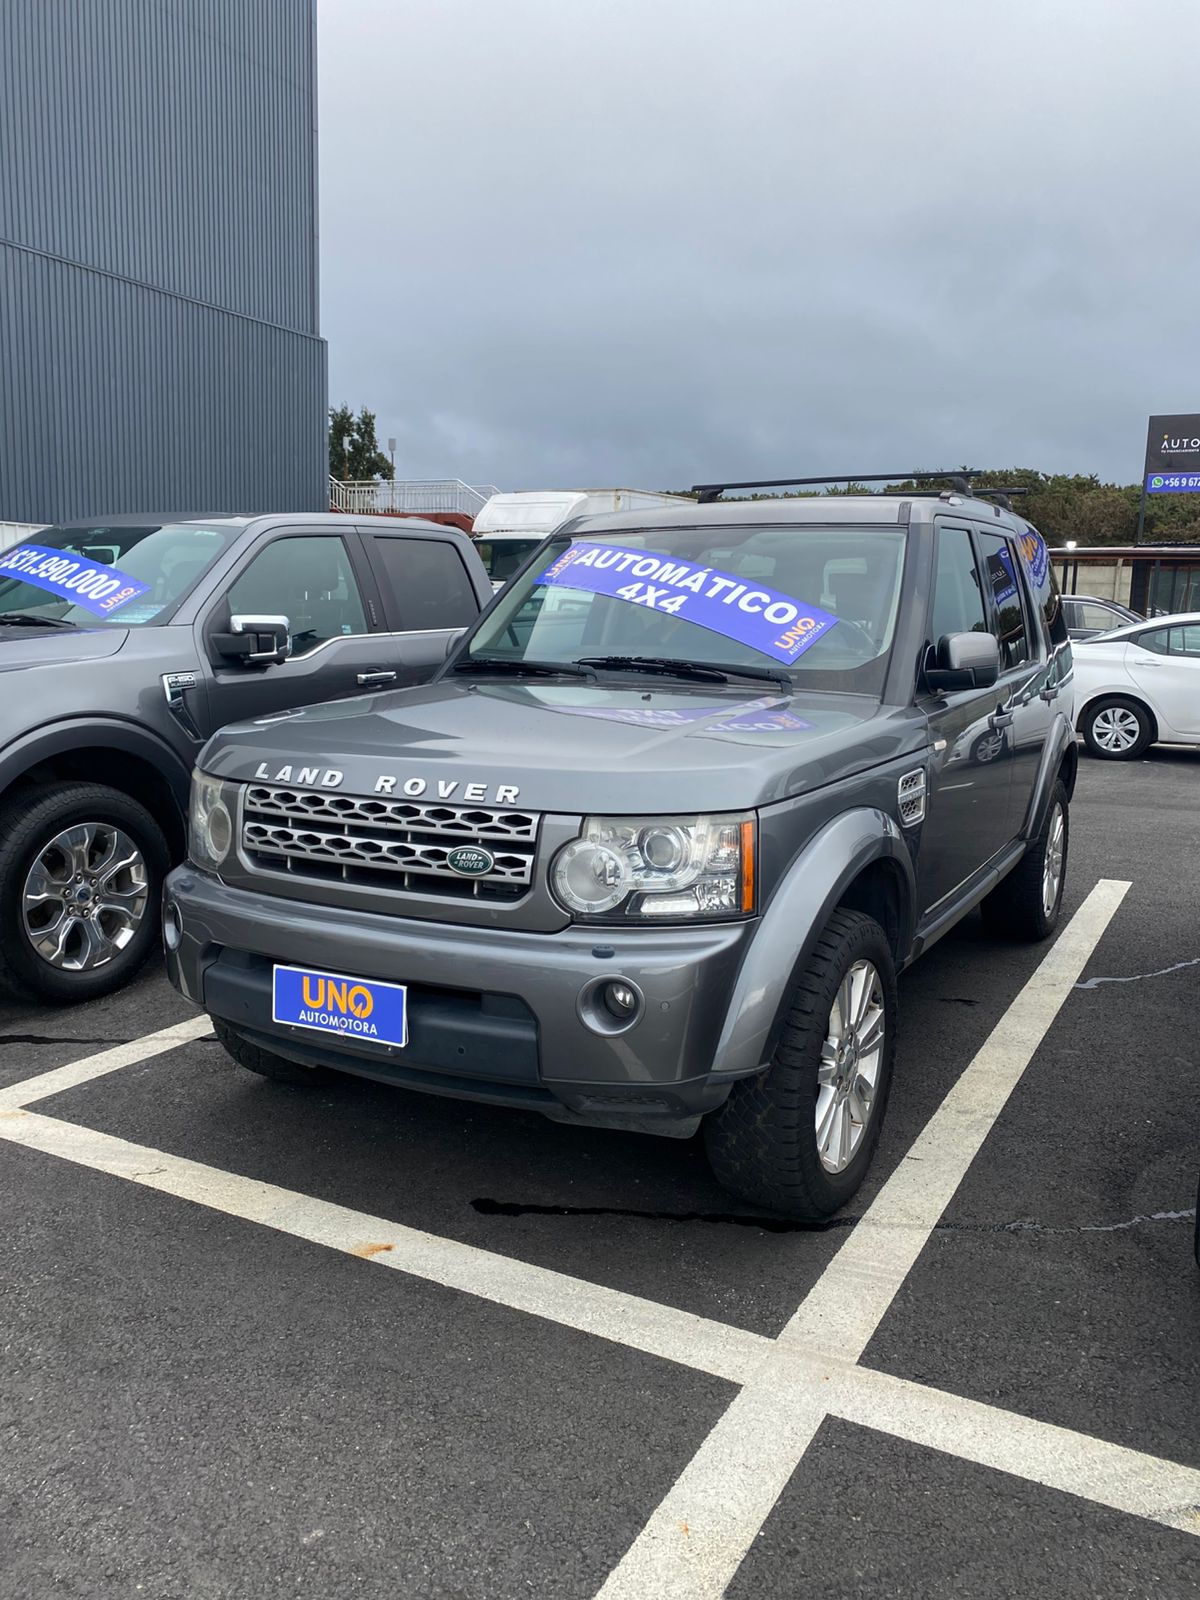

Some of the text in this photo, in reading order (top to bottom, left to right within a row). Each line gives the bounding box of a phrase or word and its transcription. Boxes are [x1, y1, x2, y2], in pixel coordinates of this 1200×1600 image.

[1165, 477, 1179, 487] +56
[1181, 477, 1187, 487] 9
[573, 548, 799, 626] AUTOMÁTICO
[615, 581, 689, 615] 4X4
[774, 617, 816, 649] UNO
[254, 763, 520, 804] LAND ROVER
[302, 976, 374, 1019] UNO
[298, 1010, 378, 1035] AUTOMOTORA
